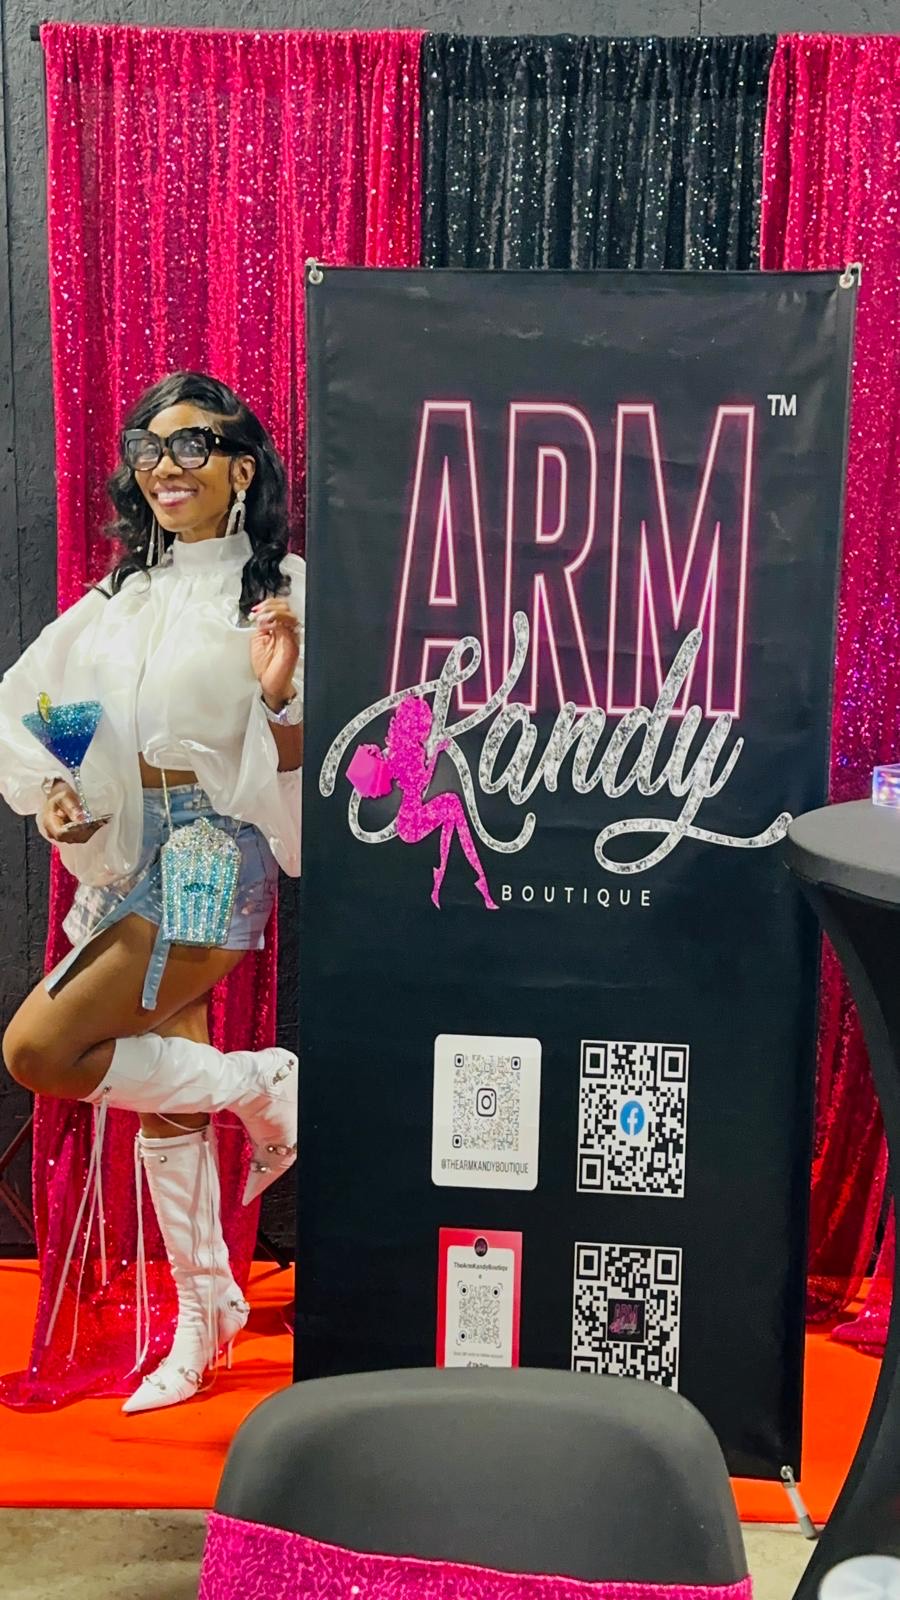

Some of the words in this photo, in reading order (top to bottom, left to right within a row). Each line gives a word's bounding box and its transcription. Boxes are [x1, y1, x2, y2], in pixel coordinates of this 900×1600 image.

[390, 401, 755, 719] ARM
[767, 394, 798, 417] TM
[319, 611, 793, 874] Kandy
[501, 885, 652, 907] BOUTIQUE
[441, 1158, 529, 1175] @THEARMKANDYBOUTIQUE
